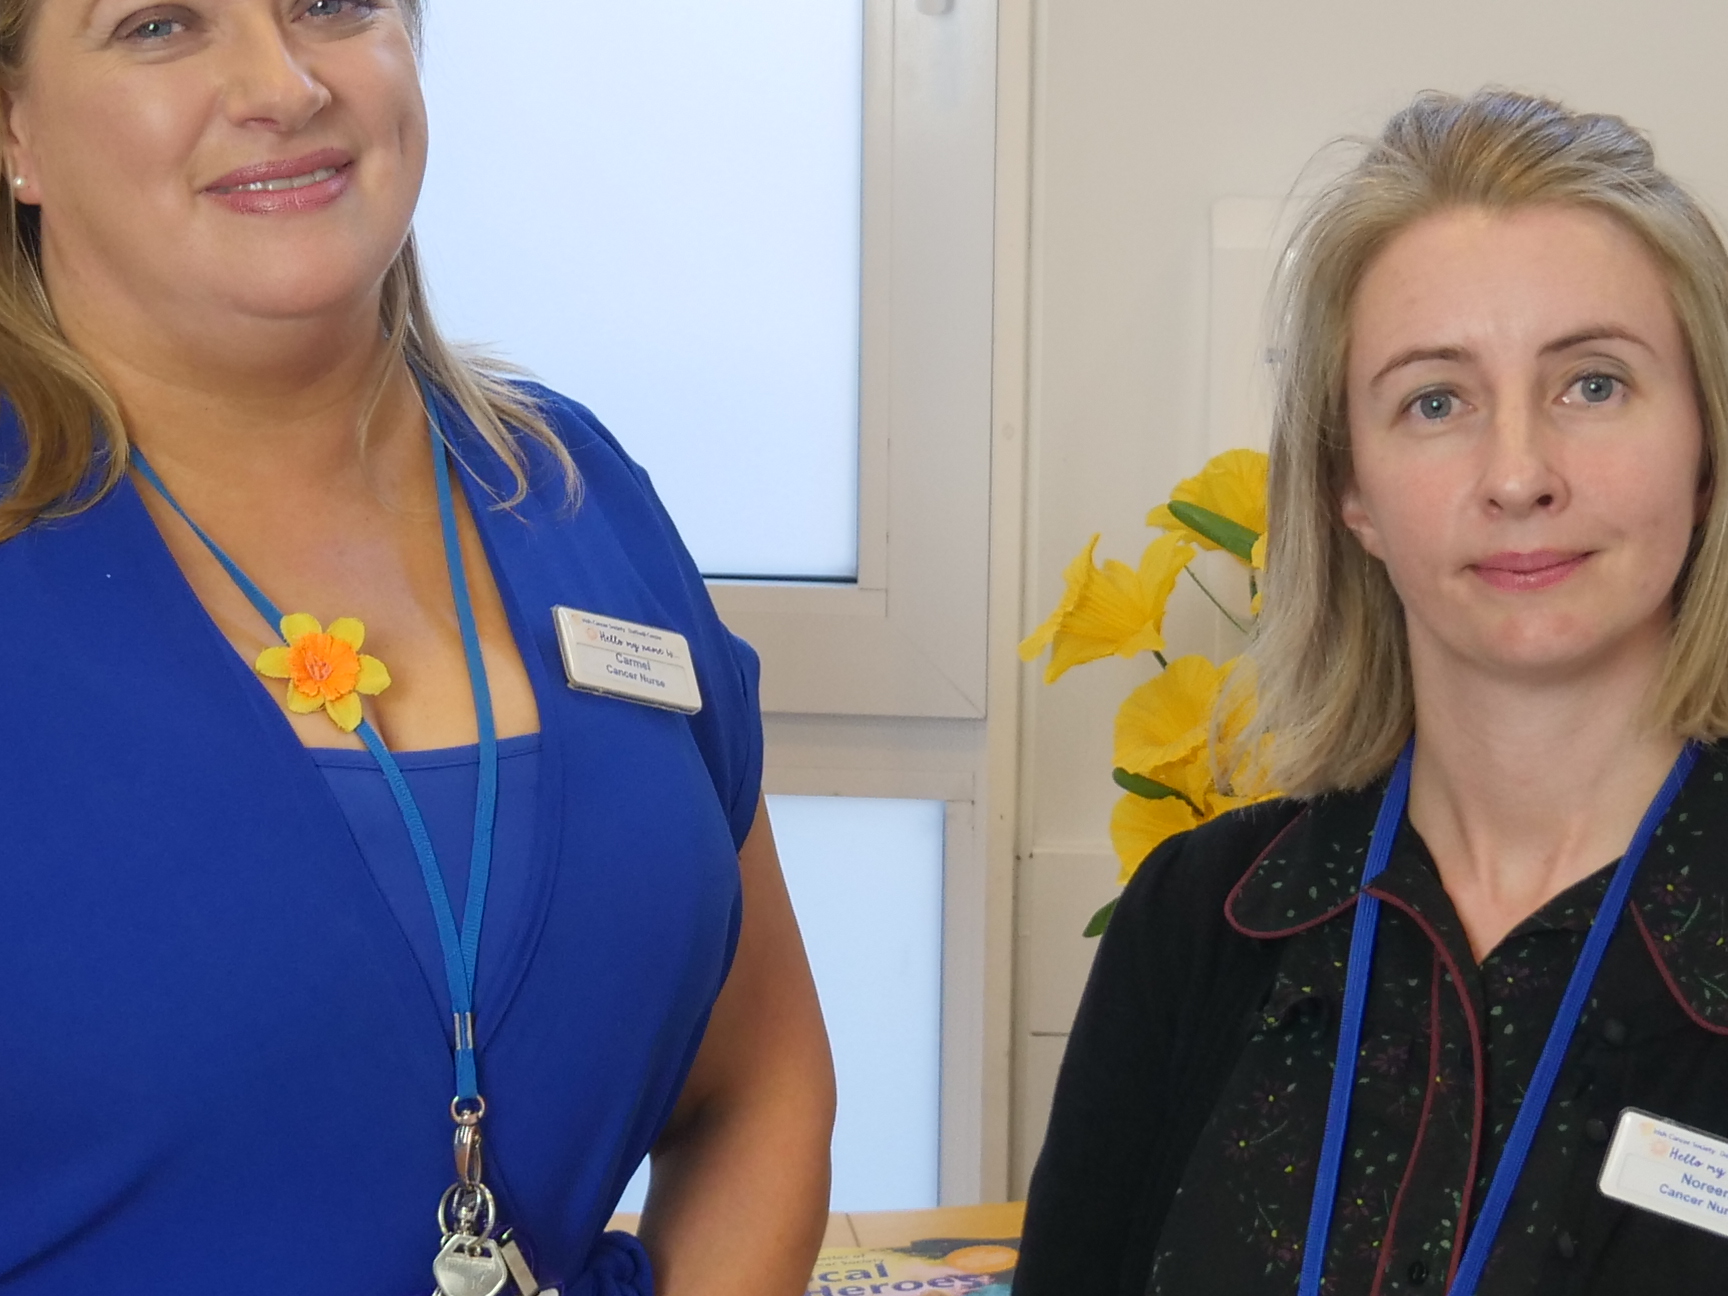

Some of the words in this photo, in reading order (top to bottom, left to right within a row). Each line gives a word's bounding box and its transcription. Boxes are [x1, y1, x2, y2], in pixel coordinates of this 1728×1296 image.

[600, 630, 623, 646] Hello
[626, 641, 639, 653] my
[642, 645, 664, 655] name
[616, 652, 651, 671] Carmel
[606, 664, 637, 680] Cancer
[640, 673, 665, 687] Nurse
[1669, 1147, 1703, 1167] Hello
[1707, 1164, 1726, 1179] my
[1659, 1183, 1704, 1206] Cancer
